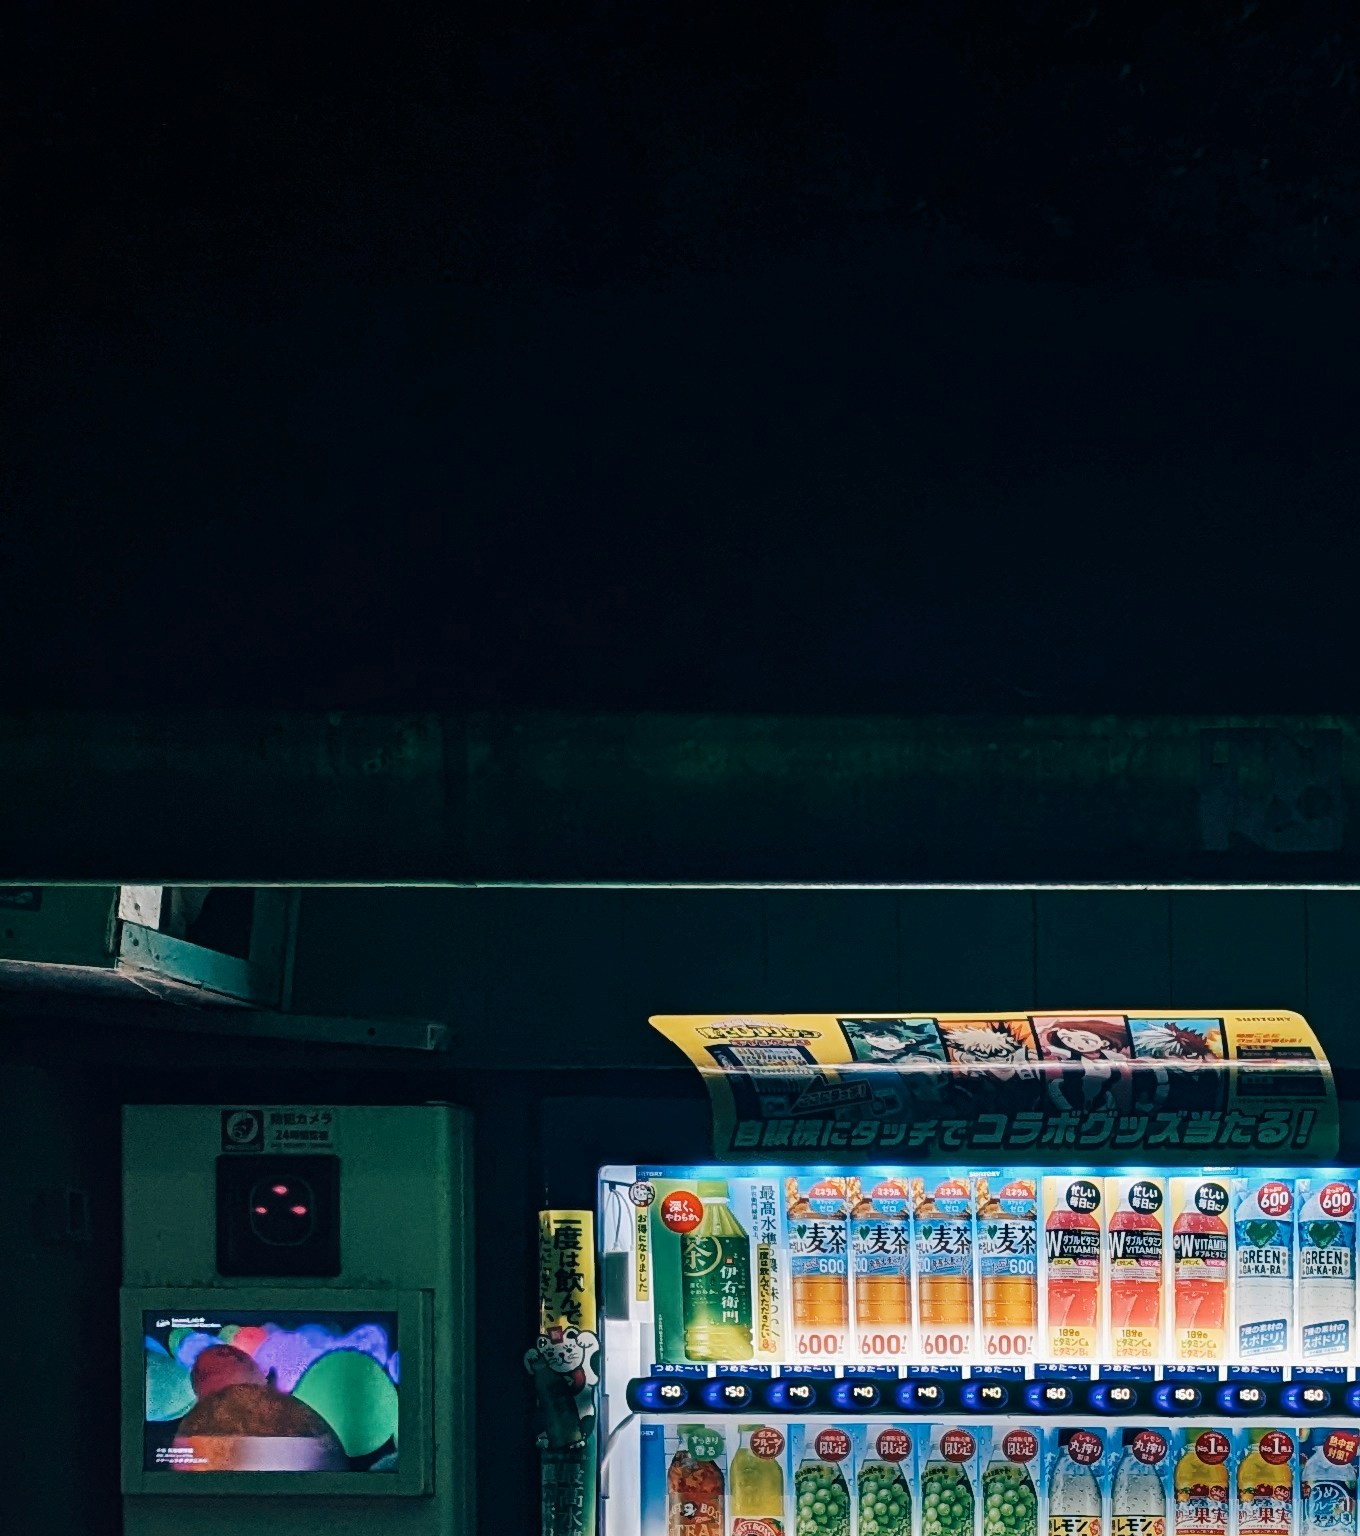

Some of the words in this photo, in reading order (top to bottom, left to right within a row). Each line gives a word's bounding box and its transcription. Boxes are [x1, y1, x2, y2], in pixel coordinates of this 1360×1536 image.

[1071, 1185, 1095, 1197] 忙しい
[1134, 1186, 1157, 1198] 忙しい
[806, 1224, 847, 1254] 麦茶
[869, 1224, 910, 1254] 麦茶
[933, 1224, 973, 1254] 麦茶
[997, 1224, 1037, 1254] 麦茶
[638, 1214, 649, 1293] お得になりました
[1242, 1251, 1281, 1264] GREEN
[1306, 1251, 1343, 1265] GREEN
[553, 1218, 585, 1326] 一度は飲んで
[819, 1260, 844, 1273] 600
[1009, 1260, 1034, 1274] 600
[720, 1266, 739, 1323] 伊右衛門
[820, 1441, 846, 1455] 限定
[880, 1441, 907, 1455] 限定
[945, 1442, 971, 1456] 限定
[1329, 1436, 1353, 1451] 熱中症
[1313, 1488, 1339, 1499] うめ
[1054, 1518, 1088, 1533] レモン
[1118, 1518, 1152, 1533] レモン
